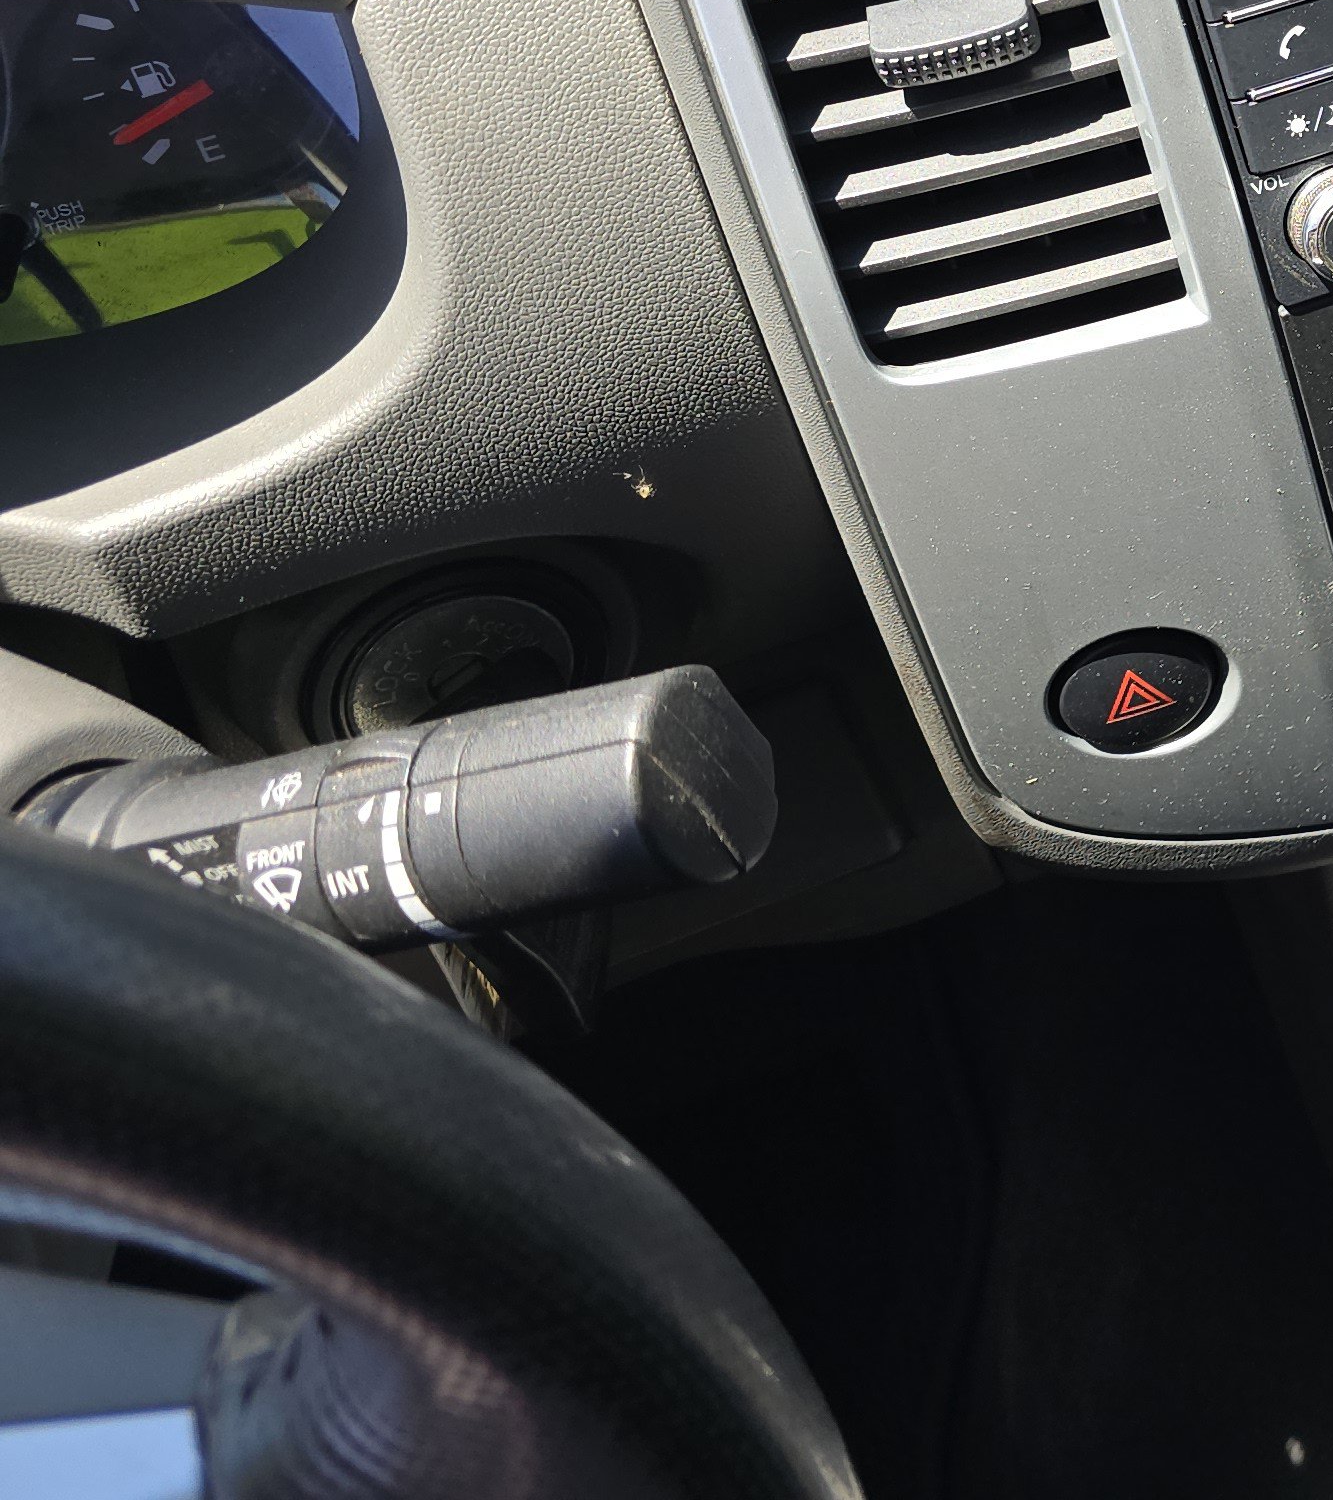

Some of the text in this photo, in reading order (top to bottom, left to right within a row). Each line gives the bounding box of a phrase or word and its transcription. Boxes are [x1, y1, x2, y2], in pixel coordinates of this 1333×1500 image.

[195, 134, 226, 163] E
[1250, 174, 1289, 196] VOL
[36, 200, 85, 221] PUSH
[45, 214, 86, 236] TRIP
[173, 835, 219, 857] MIST
[246, 840, 306, 873] FRONT
[203, 862, 240, 883] OFF
[325, 864, 369, 899] INT
